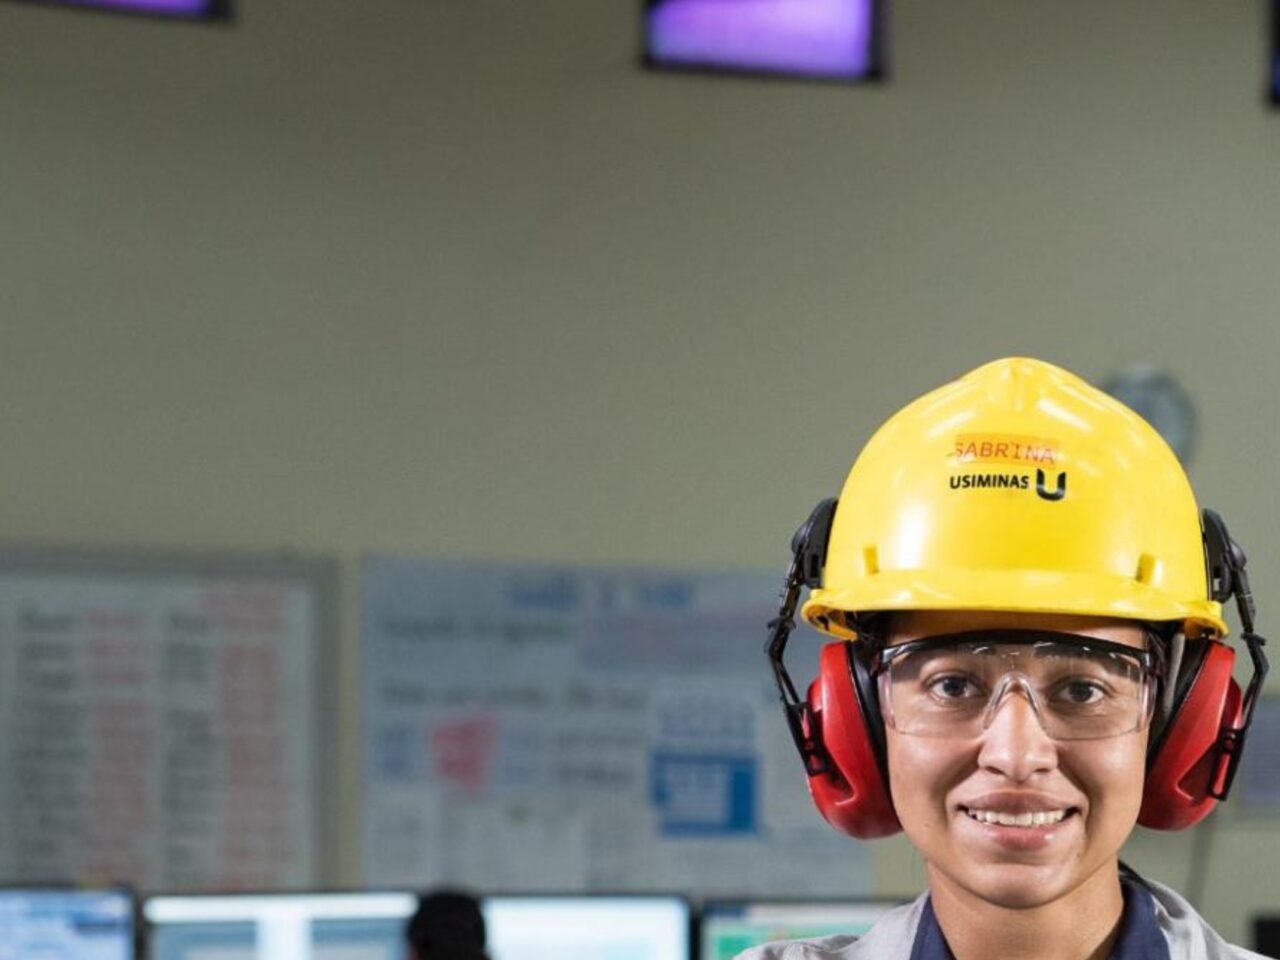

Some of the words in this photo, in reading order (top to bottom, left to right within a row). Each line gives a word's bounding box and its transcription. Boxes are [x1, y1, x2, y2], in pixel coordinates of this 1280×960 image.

[955, 442, 1055, 462] SABRINA
[949, 474, 1030, 490] USIMINAS
[1036, 468, 1067, 501] U
